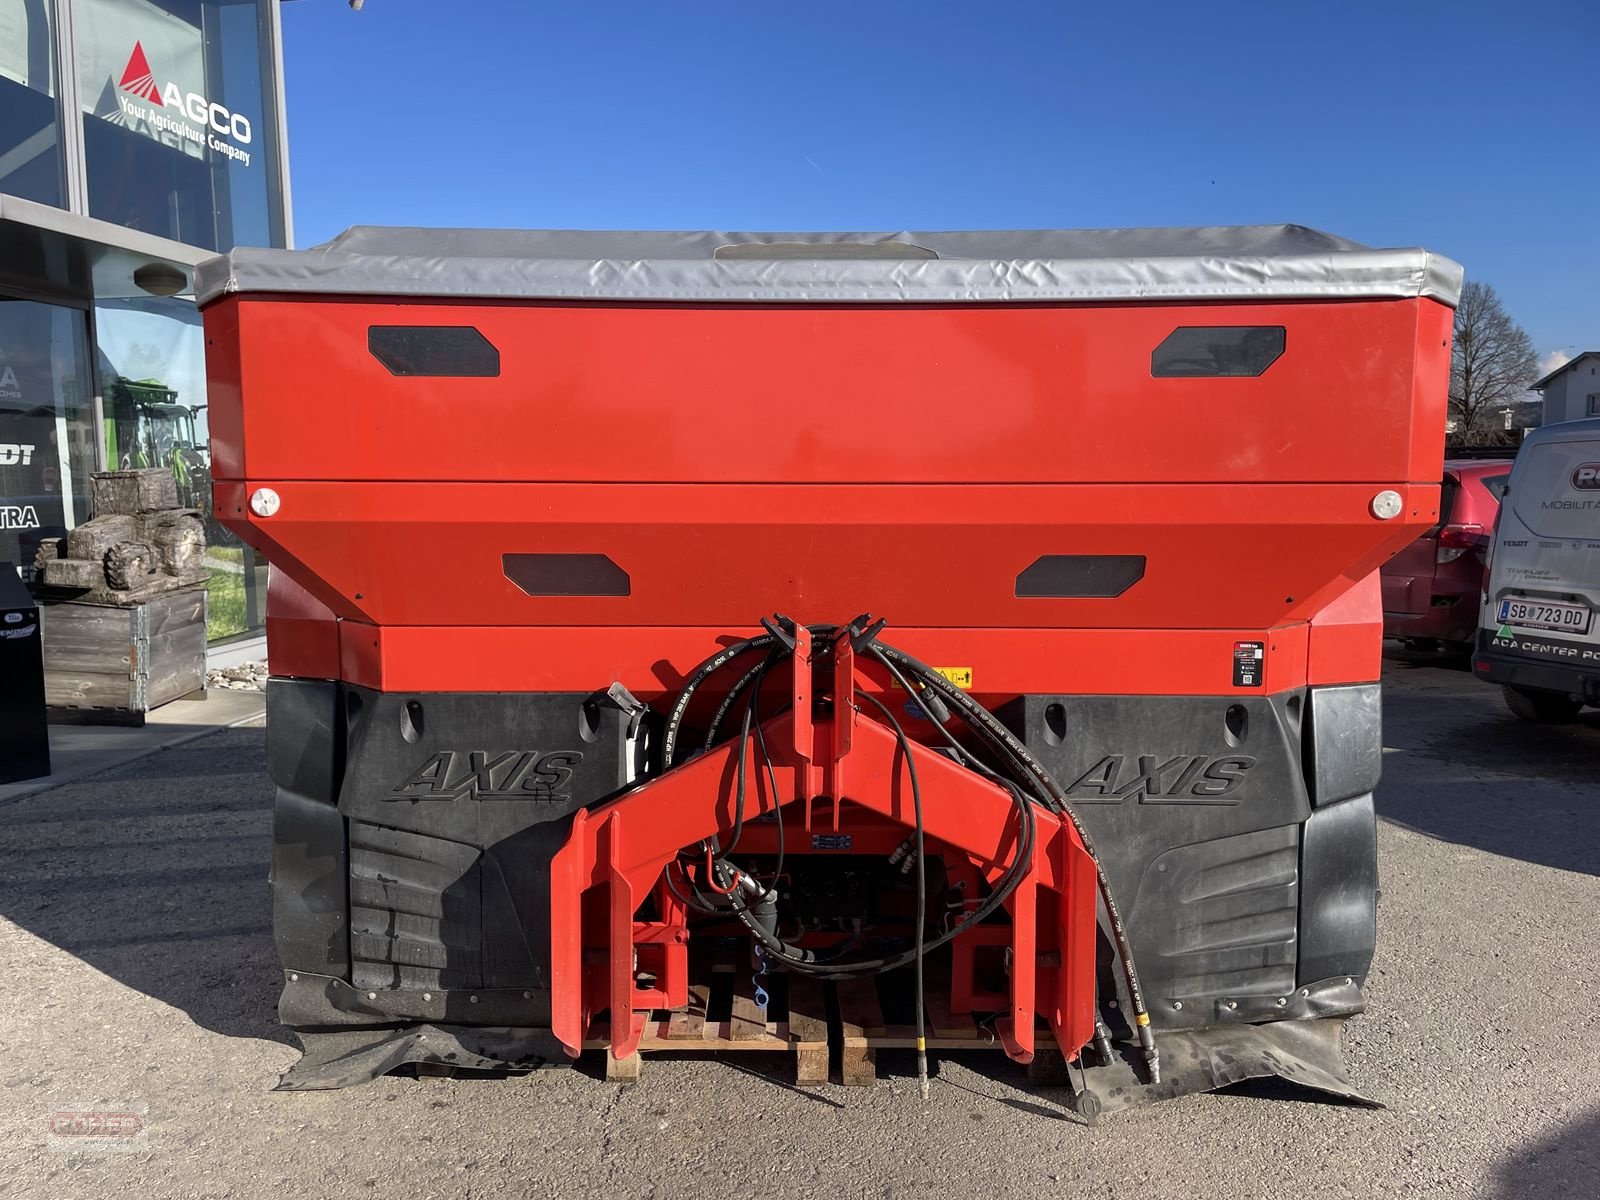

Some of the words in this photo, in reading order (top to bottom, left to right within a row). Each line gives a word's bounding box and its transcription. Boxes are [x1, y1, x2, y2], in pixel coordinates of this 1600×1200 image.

[120, 96, 146, 119] Your
[149, 109, 206, 145] Agriculture
[207, 134, 251, 167] Company
[163, 82, 251, 144] AGCO
[1510, 604, 1527, 619] SB
[1536, 607, 1562, 623] 723
[1564, 610, 1583, 626] DD
[1492, 638, 1519, 649] ACA
[1522, 642, 1578, 657] CENTER
[392, 750, 584, 792] AXIS
[1064, 754, 1258, 796] AXIS
